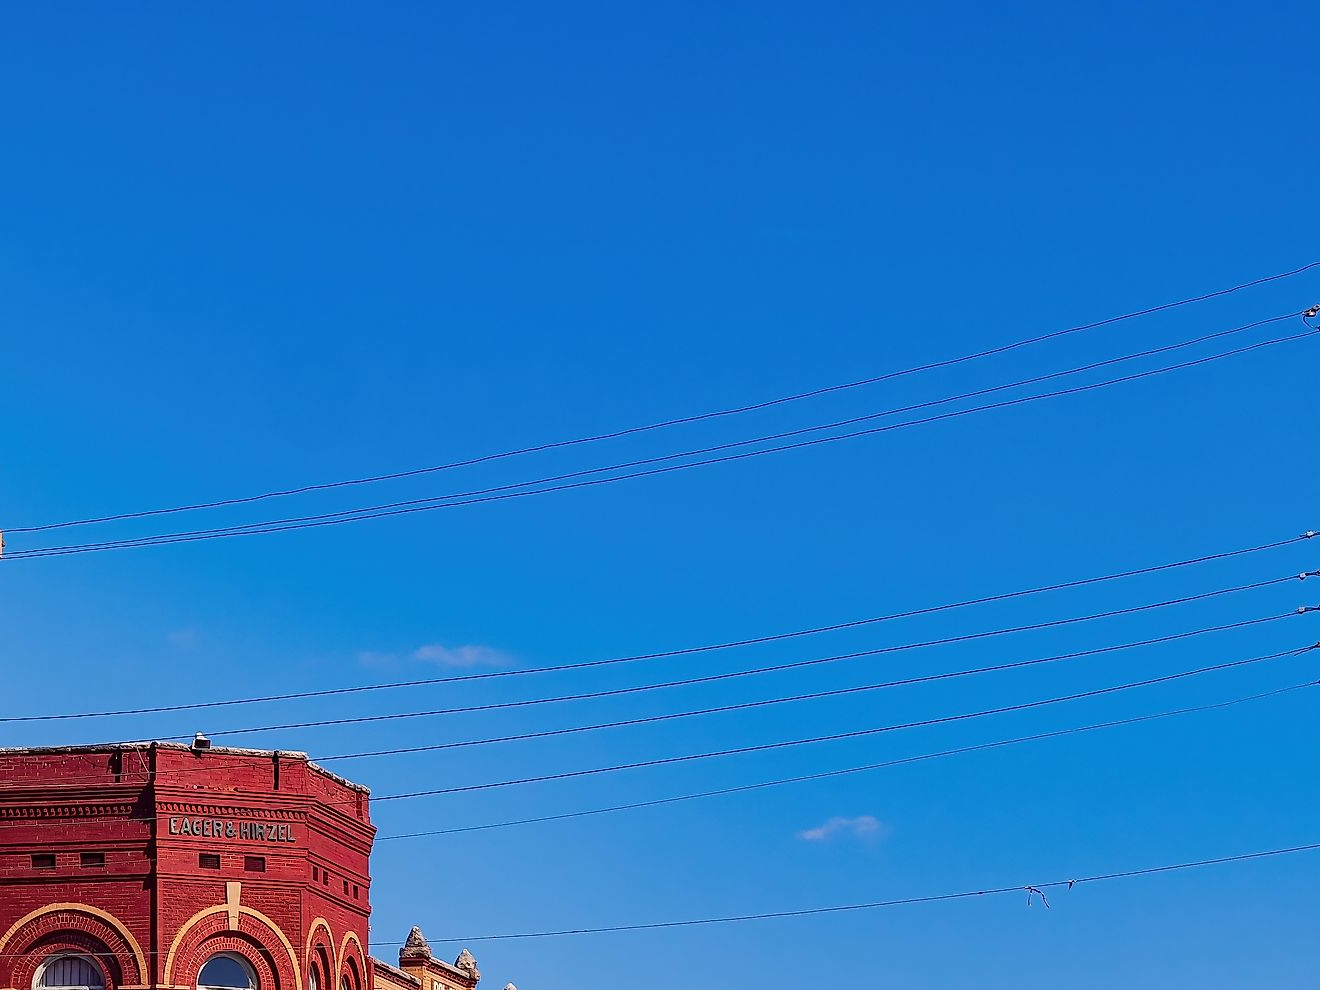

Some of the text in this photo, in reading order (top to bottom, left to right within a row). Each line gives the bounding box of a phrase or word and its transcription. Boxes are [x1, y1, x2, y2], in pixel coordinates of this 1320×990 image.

[169, 817, 297, 843] EAGER & HIRZEL
